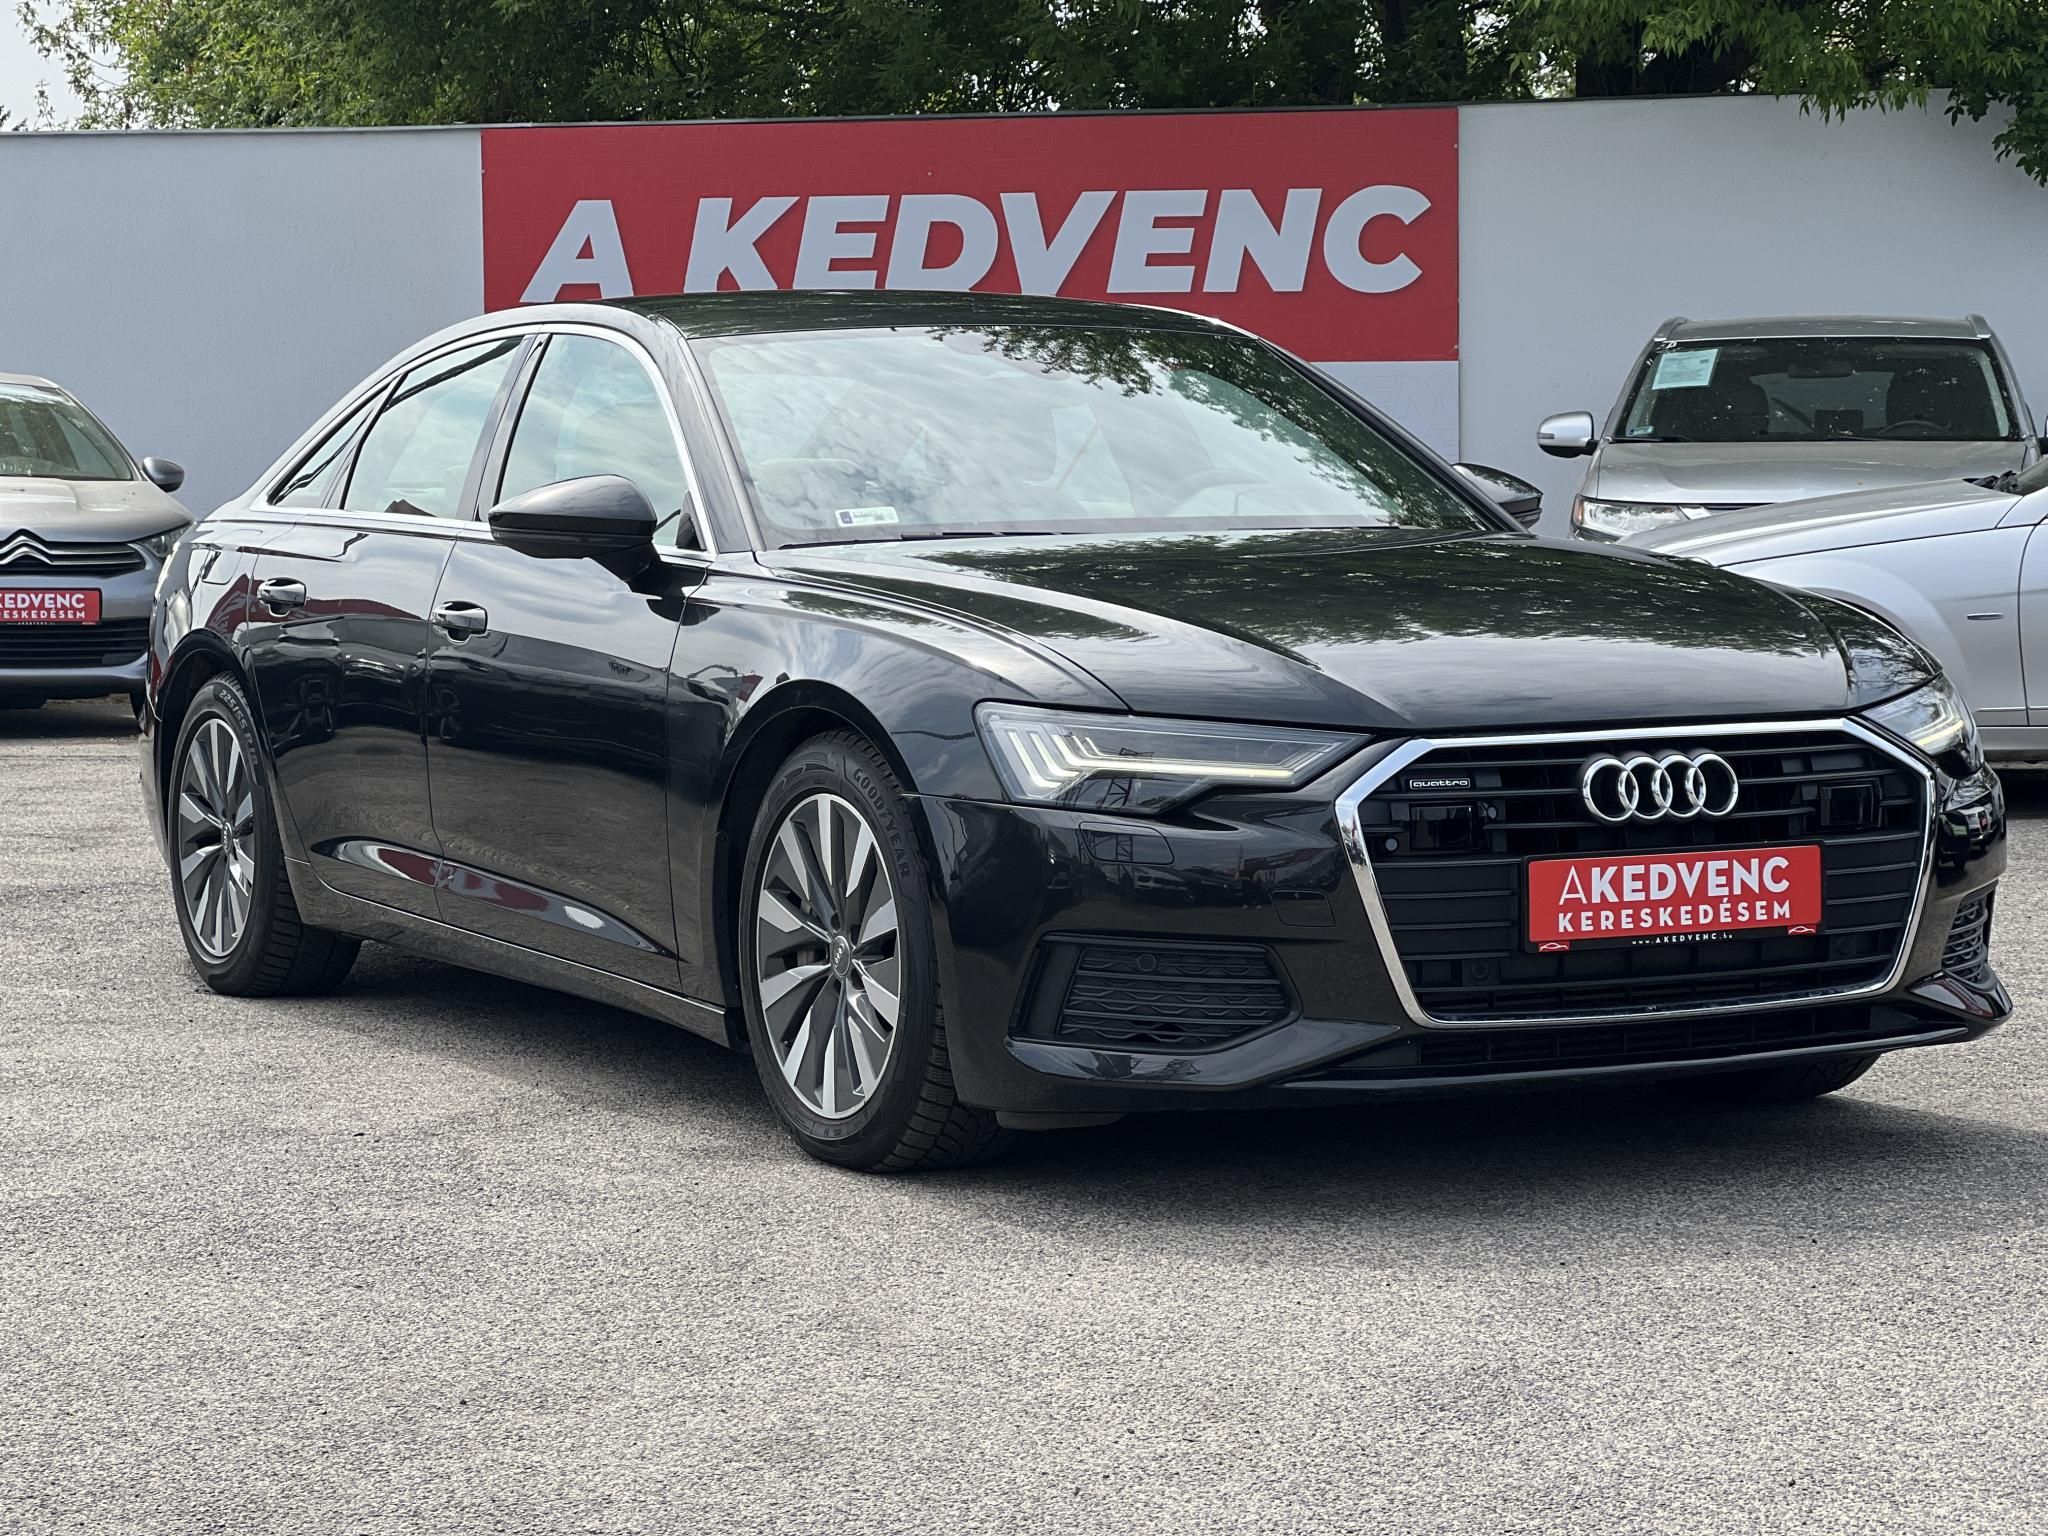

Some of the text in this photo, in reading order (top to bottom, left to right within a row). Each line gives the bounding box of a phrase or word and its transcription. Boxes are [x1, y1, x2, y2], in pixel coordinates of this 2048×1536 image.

[520, 184, 1433, 303] A KEDVENC
[0, 593, 86, 609] EDVENC
[0, 607, 86, 619] ESKEDÉSEM
[1413, 779, 1468, 788] quattro
[853, 768, 910, 878] GOODYEAR
[1558, 856, 1790, 906] AKEDVENC
[1558, 898, 1791, 933] KERESKEDÉSEM
